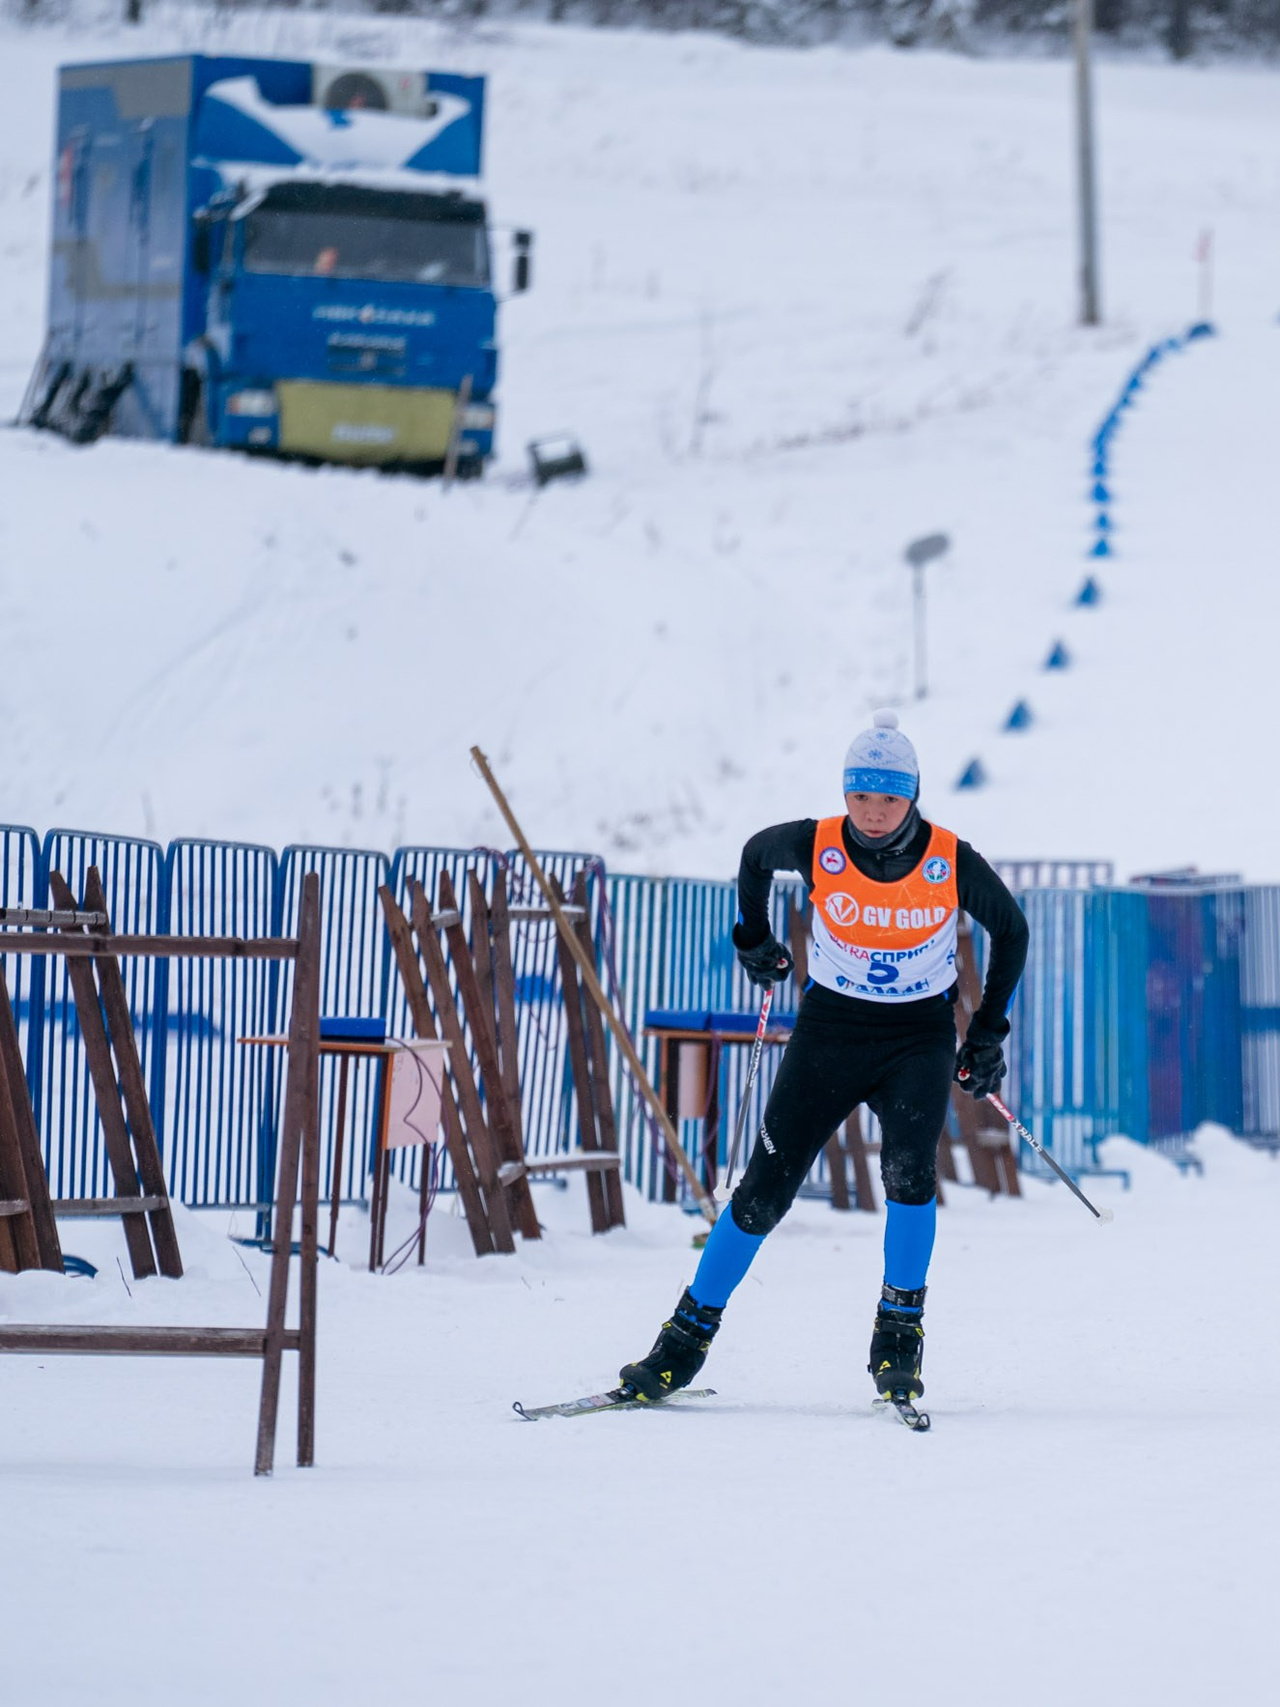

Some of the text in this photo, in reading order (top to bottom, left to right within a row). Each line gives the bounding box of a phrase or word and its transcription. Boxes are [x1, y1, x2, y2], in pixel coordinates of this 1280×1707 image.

[862, 905, 947, 930] GV GOLD
[866, 961, 900, 985] 5
